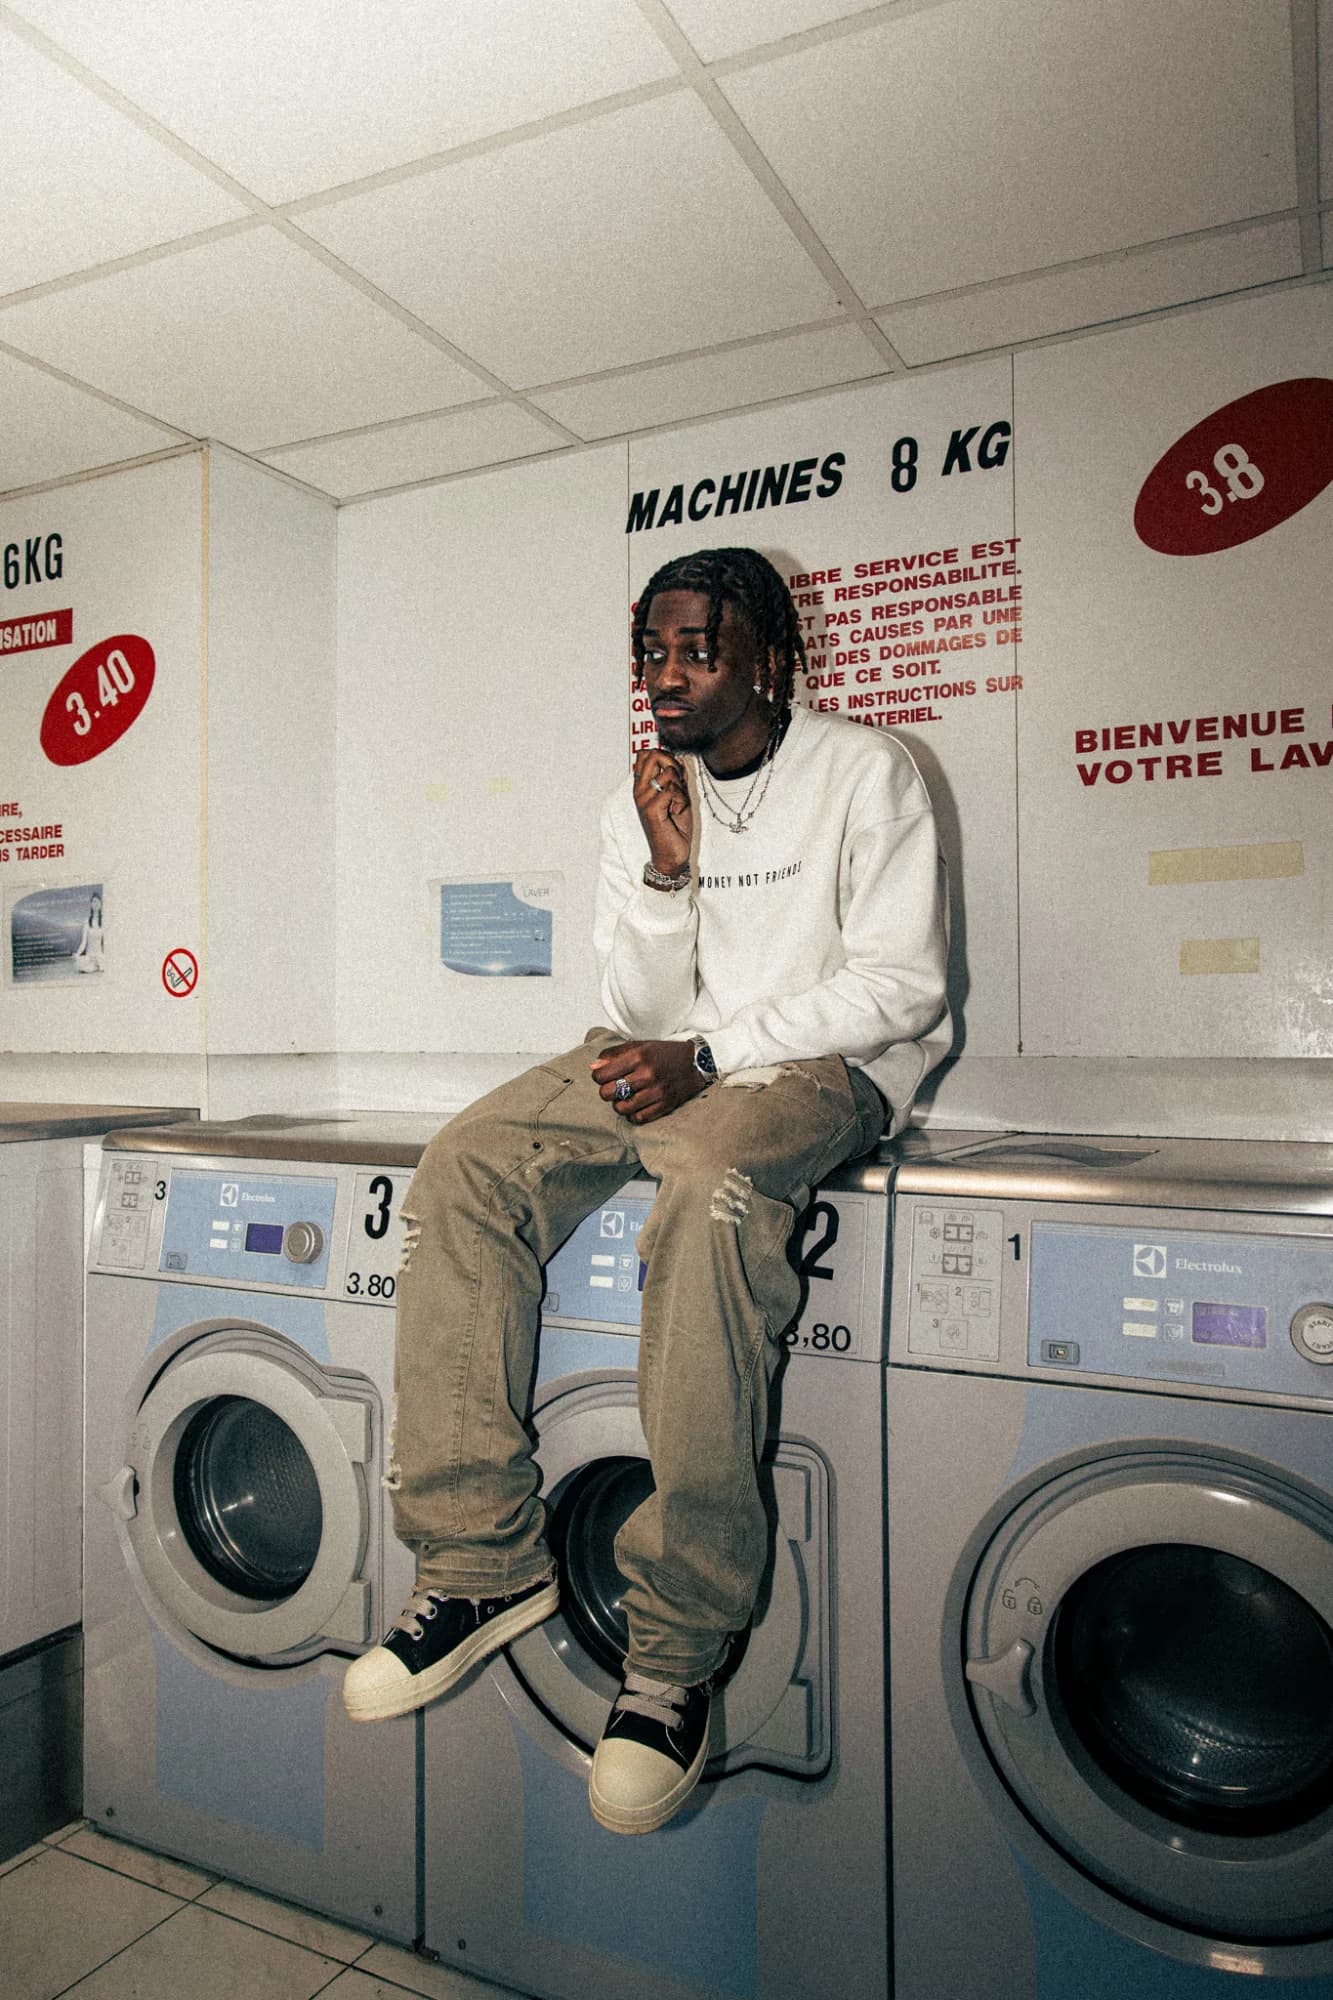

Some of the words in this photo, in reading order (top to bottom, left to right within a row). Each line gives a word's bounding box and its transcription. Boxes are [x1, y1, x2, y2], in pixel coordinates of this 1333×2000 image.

[625, 452, 846, 534] MACHINES
[891, 436, 918, 493] 8
[941, 420, 1012, 476] KG
[1185, 443, 1265, 516] 3.8
[4, 532, 63, 590] 6KG
[854, 547, 959, 579] SERVICE
[971, 538, 1021, 560] EST
[834, 560, 1022, 602] RESPONSABILITE.
[825, 609, 862, 628] PAS
[872, 585, 1022, 621] RESPONSABLE
[850, 620, 924, 644] CAUSES
[934, 613, 973, 632] PAR
[983, 606, 1022, 625] UNE
[811, 655, 828, 670] NI
[835, 648, 871, 667] DES
[879, 631, 987, 660] DOMMAGES
[996, 627, 1023, 645] DE
[65, 649, 135, 736] 3.40
[805, 672, 845, 690] QUE
[855, 667, 882, 684] CE
[892, 659, 942, 679] SOIT.
[847, 679, 976, 709] INSTRUCTIONS
[985, 674, 1024, 693] SUR
[1075, 707, 1305, 754] BIENVENUE
[1076, 751, 1223, 787] VOTRE
[1250, 741, 1333, 772] LAV
[16, 844, 65, 861] TARDER
[698, 876, 731, 888] MONEY
[738, 873, 759, 887] NOT
[766, 860, 802, 884] FRIENDS
[155, 1180, 166, 1200] 3
[364, 1175, 393, 1240] 3
[802, 1201, 840, 1281] 2
[1007, 1232, 1021, 1261] 1
[1175, 1257, 1243, 1275] Electrolux
